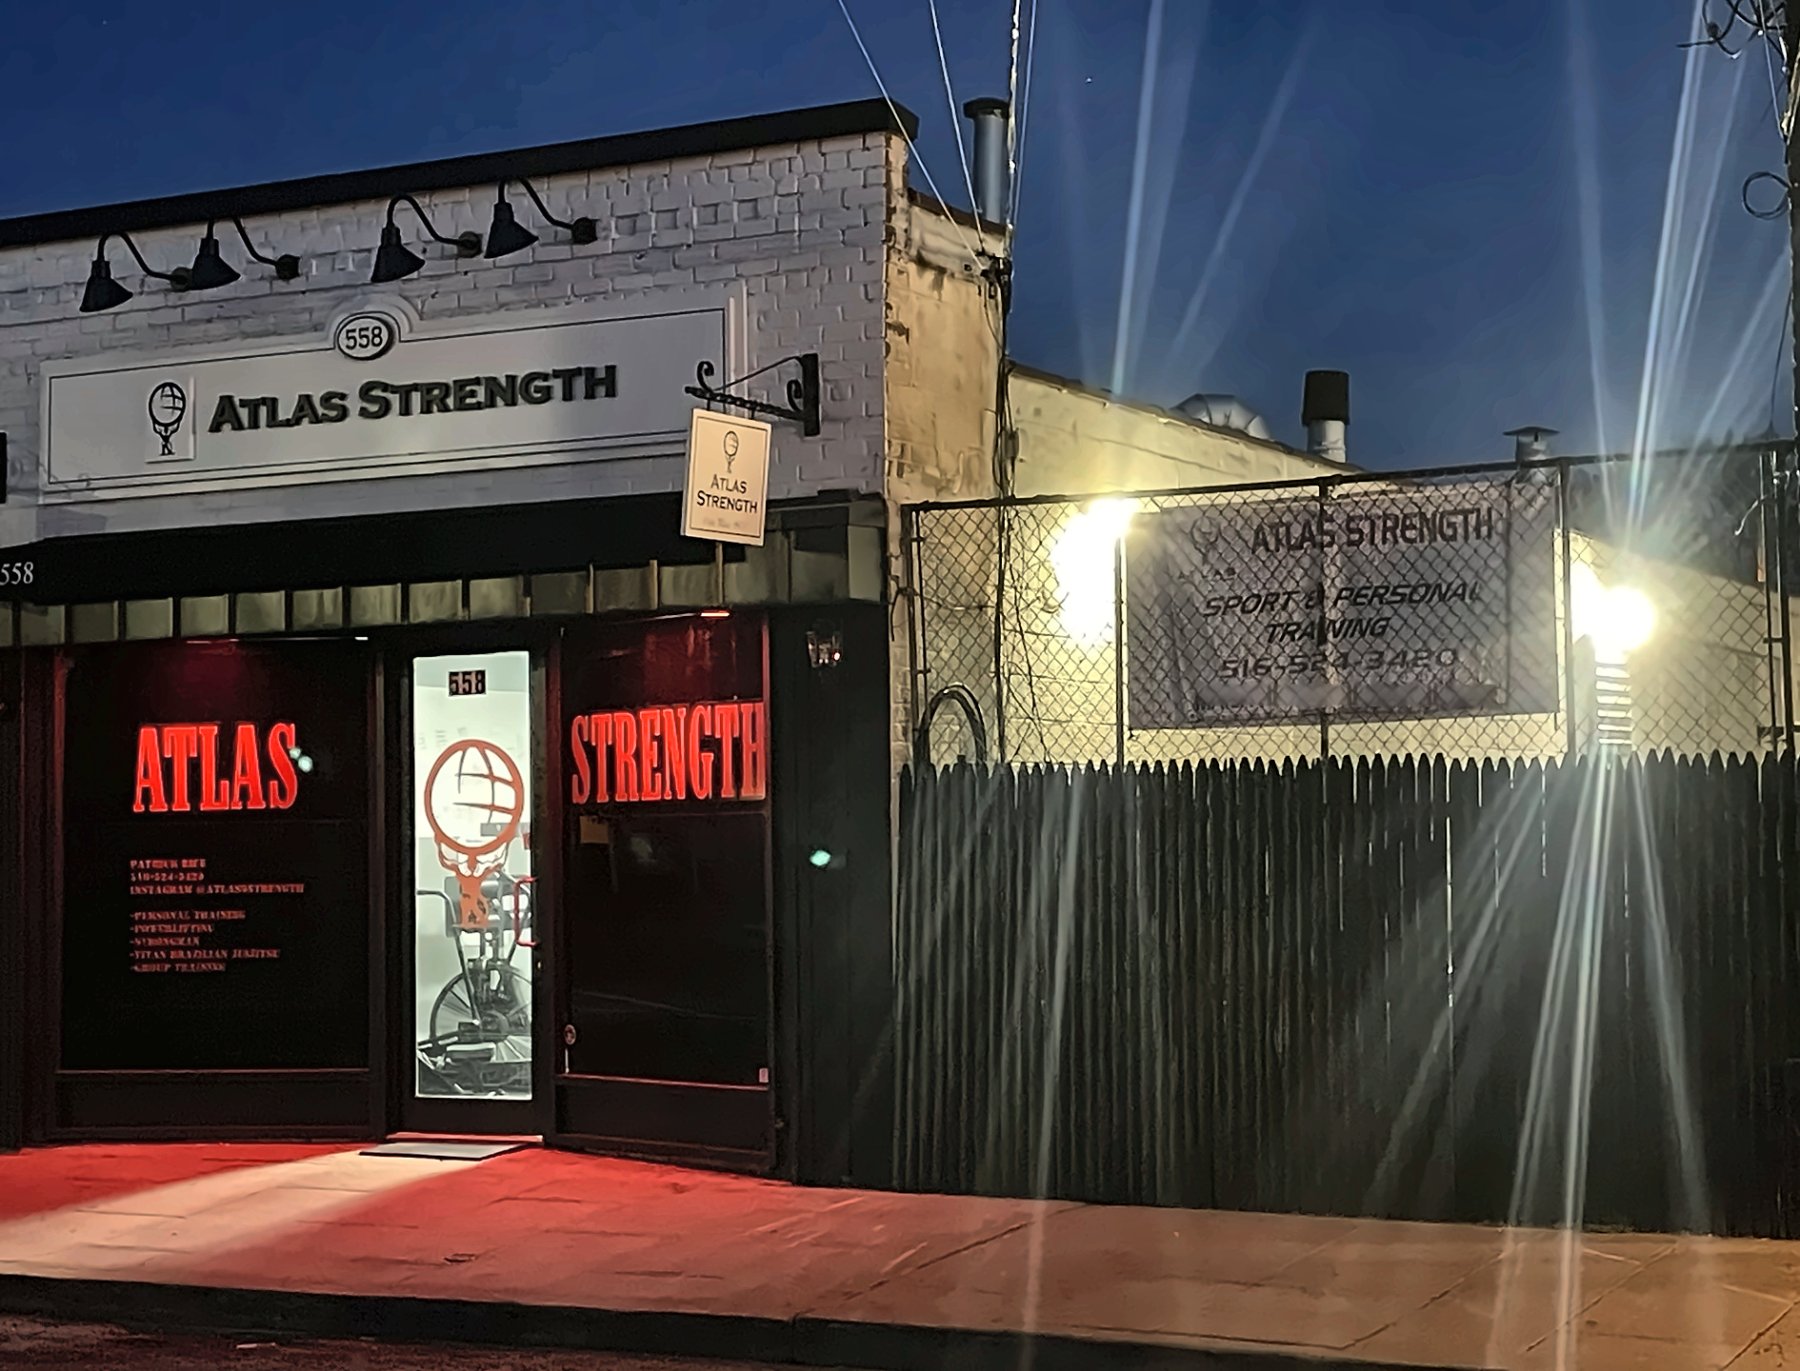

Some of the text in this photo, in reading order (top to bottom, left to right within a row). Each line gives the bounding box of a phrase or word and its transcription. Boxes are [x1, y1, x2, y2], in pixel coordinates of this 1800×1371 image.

[345, 326, 383, 350] 558
[207, 364, 618, 433] ATLAS STRENGTH
[710, 473, 748, 495] ATLAS
[696, 489, 758, 514] STRENGTH
[1252, 506, 1494, 554] ATLAS STRENGTH
[0, 561, 34, 586] 558
[1203, 590, 1300, 618] SPORT
[1333, 578, 1484, 608] PERSONAL
[1264, 617, 1392, 644] TRANING
[448, 670, 487, 697] 558
[571, 702, 767, 805] STRENGTH
[133, 722, 299, 813] ATLAS
